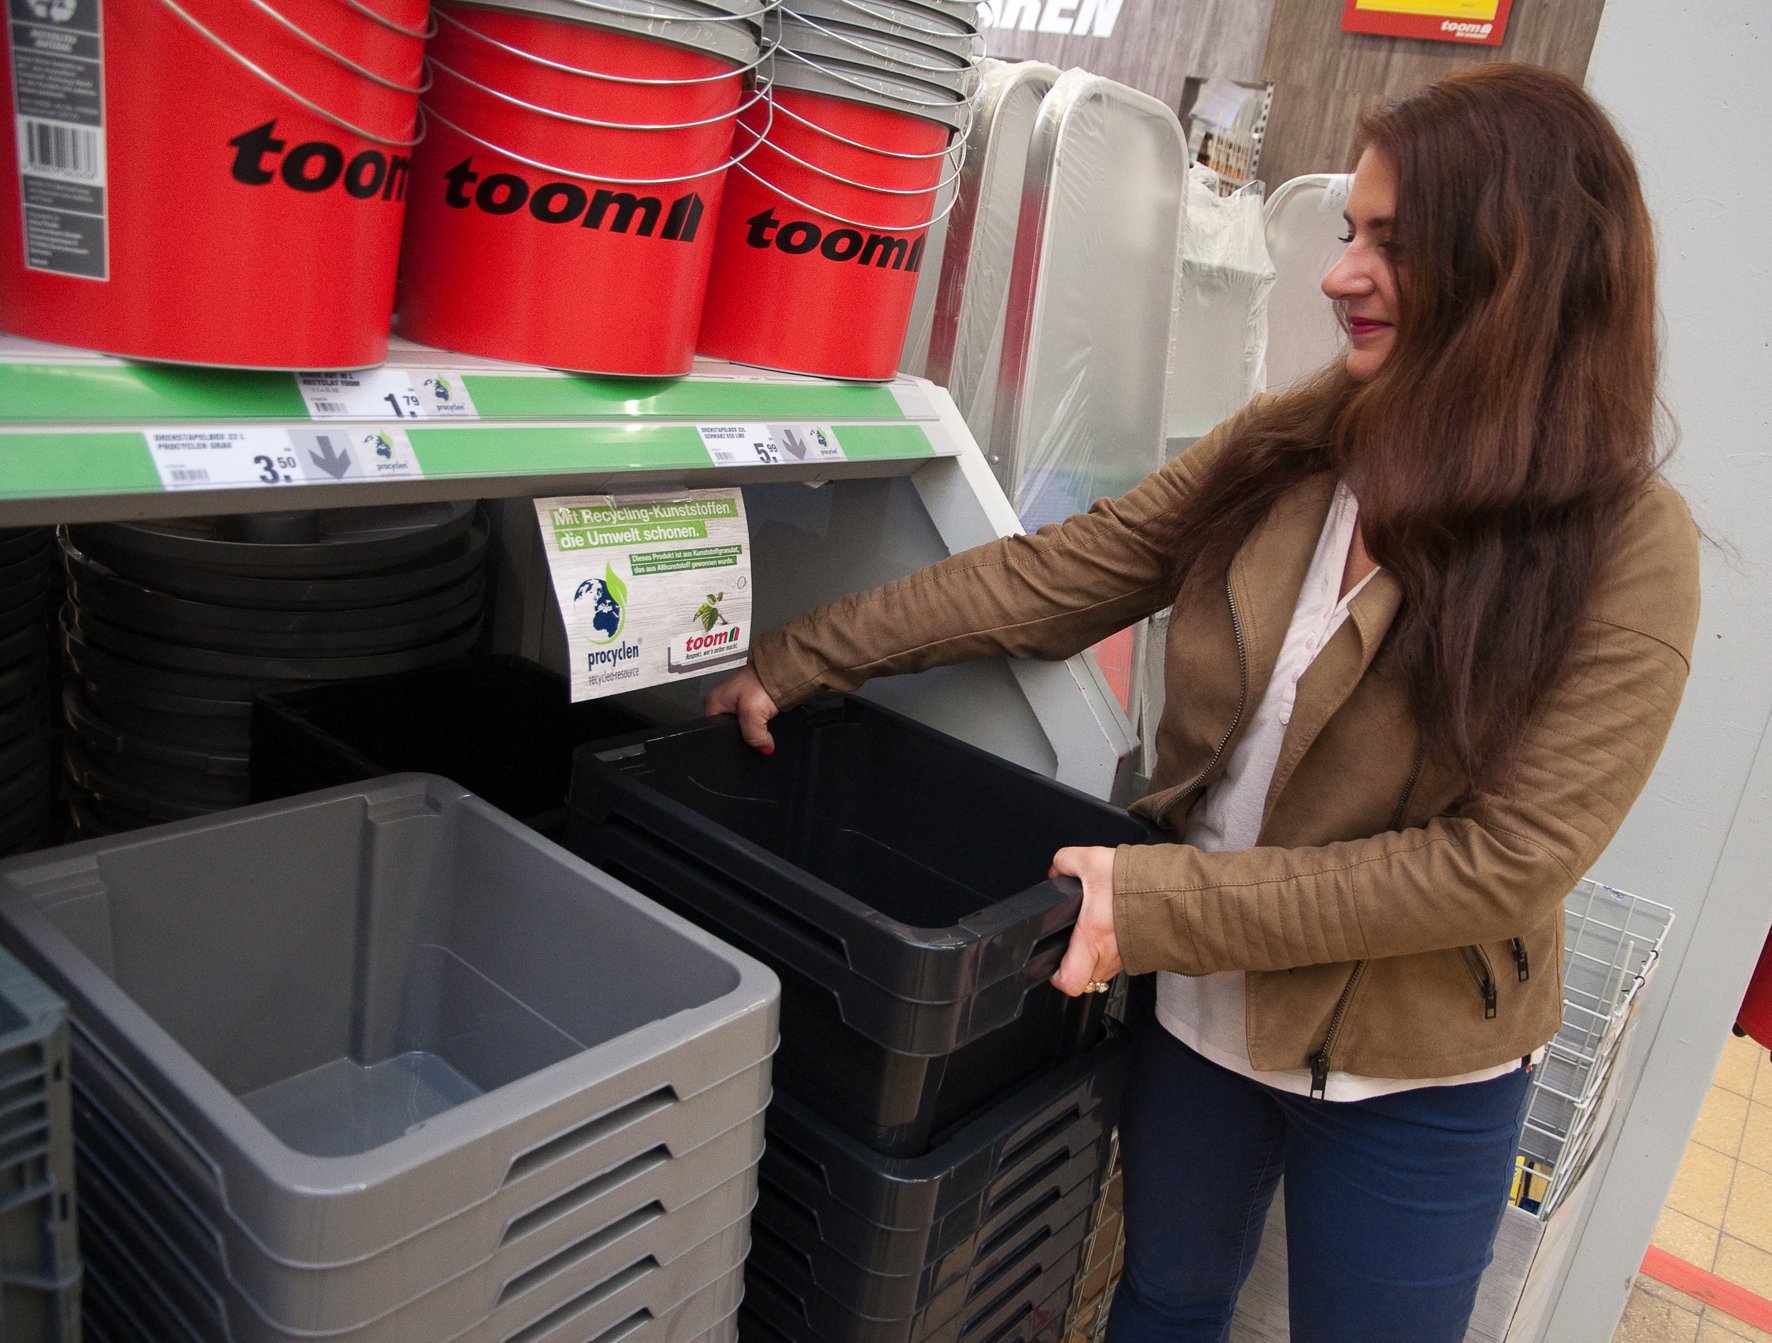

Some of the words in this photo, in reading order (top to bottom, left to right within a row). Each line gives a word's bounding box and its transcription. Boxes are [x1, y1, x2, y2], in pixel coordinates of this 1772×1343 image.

[1441, 19, 1482, 33] toom
[444, 156, 660, 238] toom
[746, 207, 907, 271] toom
[554, 509, 580, 526] Mit
[580, 502, 730, 525] Recycling-Kunststoffen
[560, 531, 585, 548] die
[587, 528, 640, 546] Umwelt
[643, 526, 700, 541] schonen.
[631, 555, 652, 563] Dieses
[657, 561, 691, 571] Altkunststoff
[691, 560, 717, 568] gewonnen
[718, 557, 734, 565] wurde.
[686, 631, 728, 652] toom
